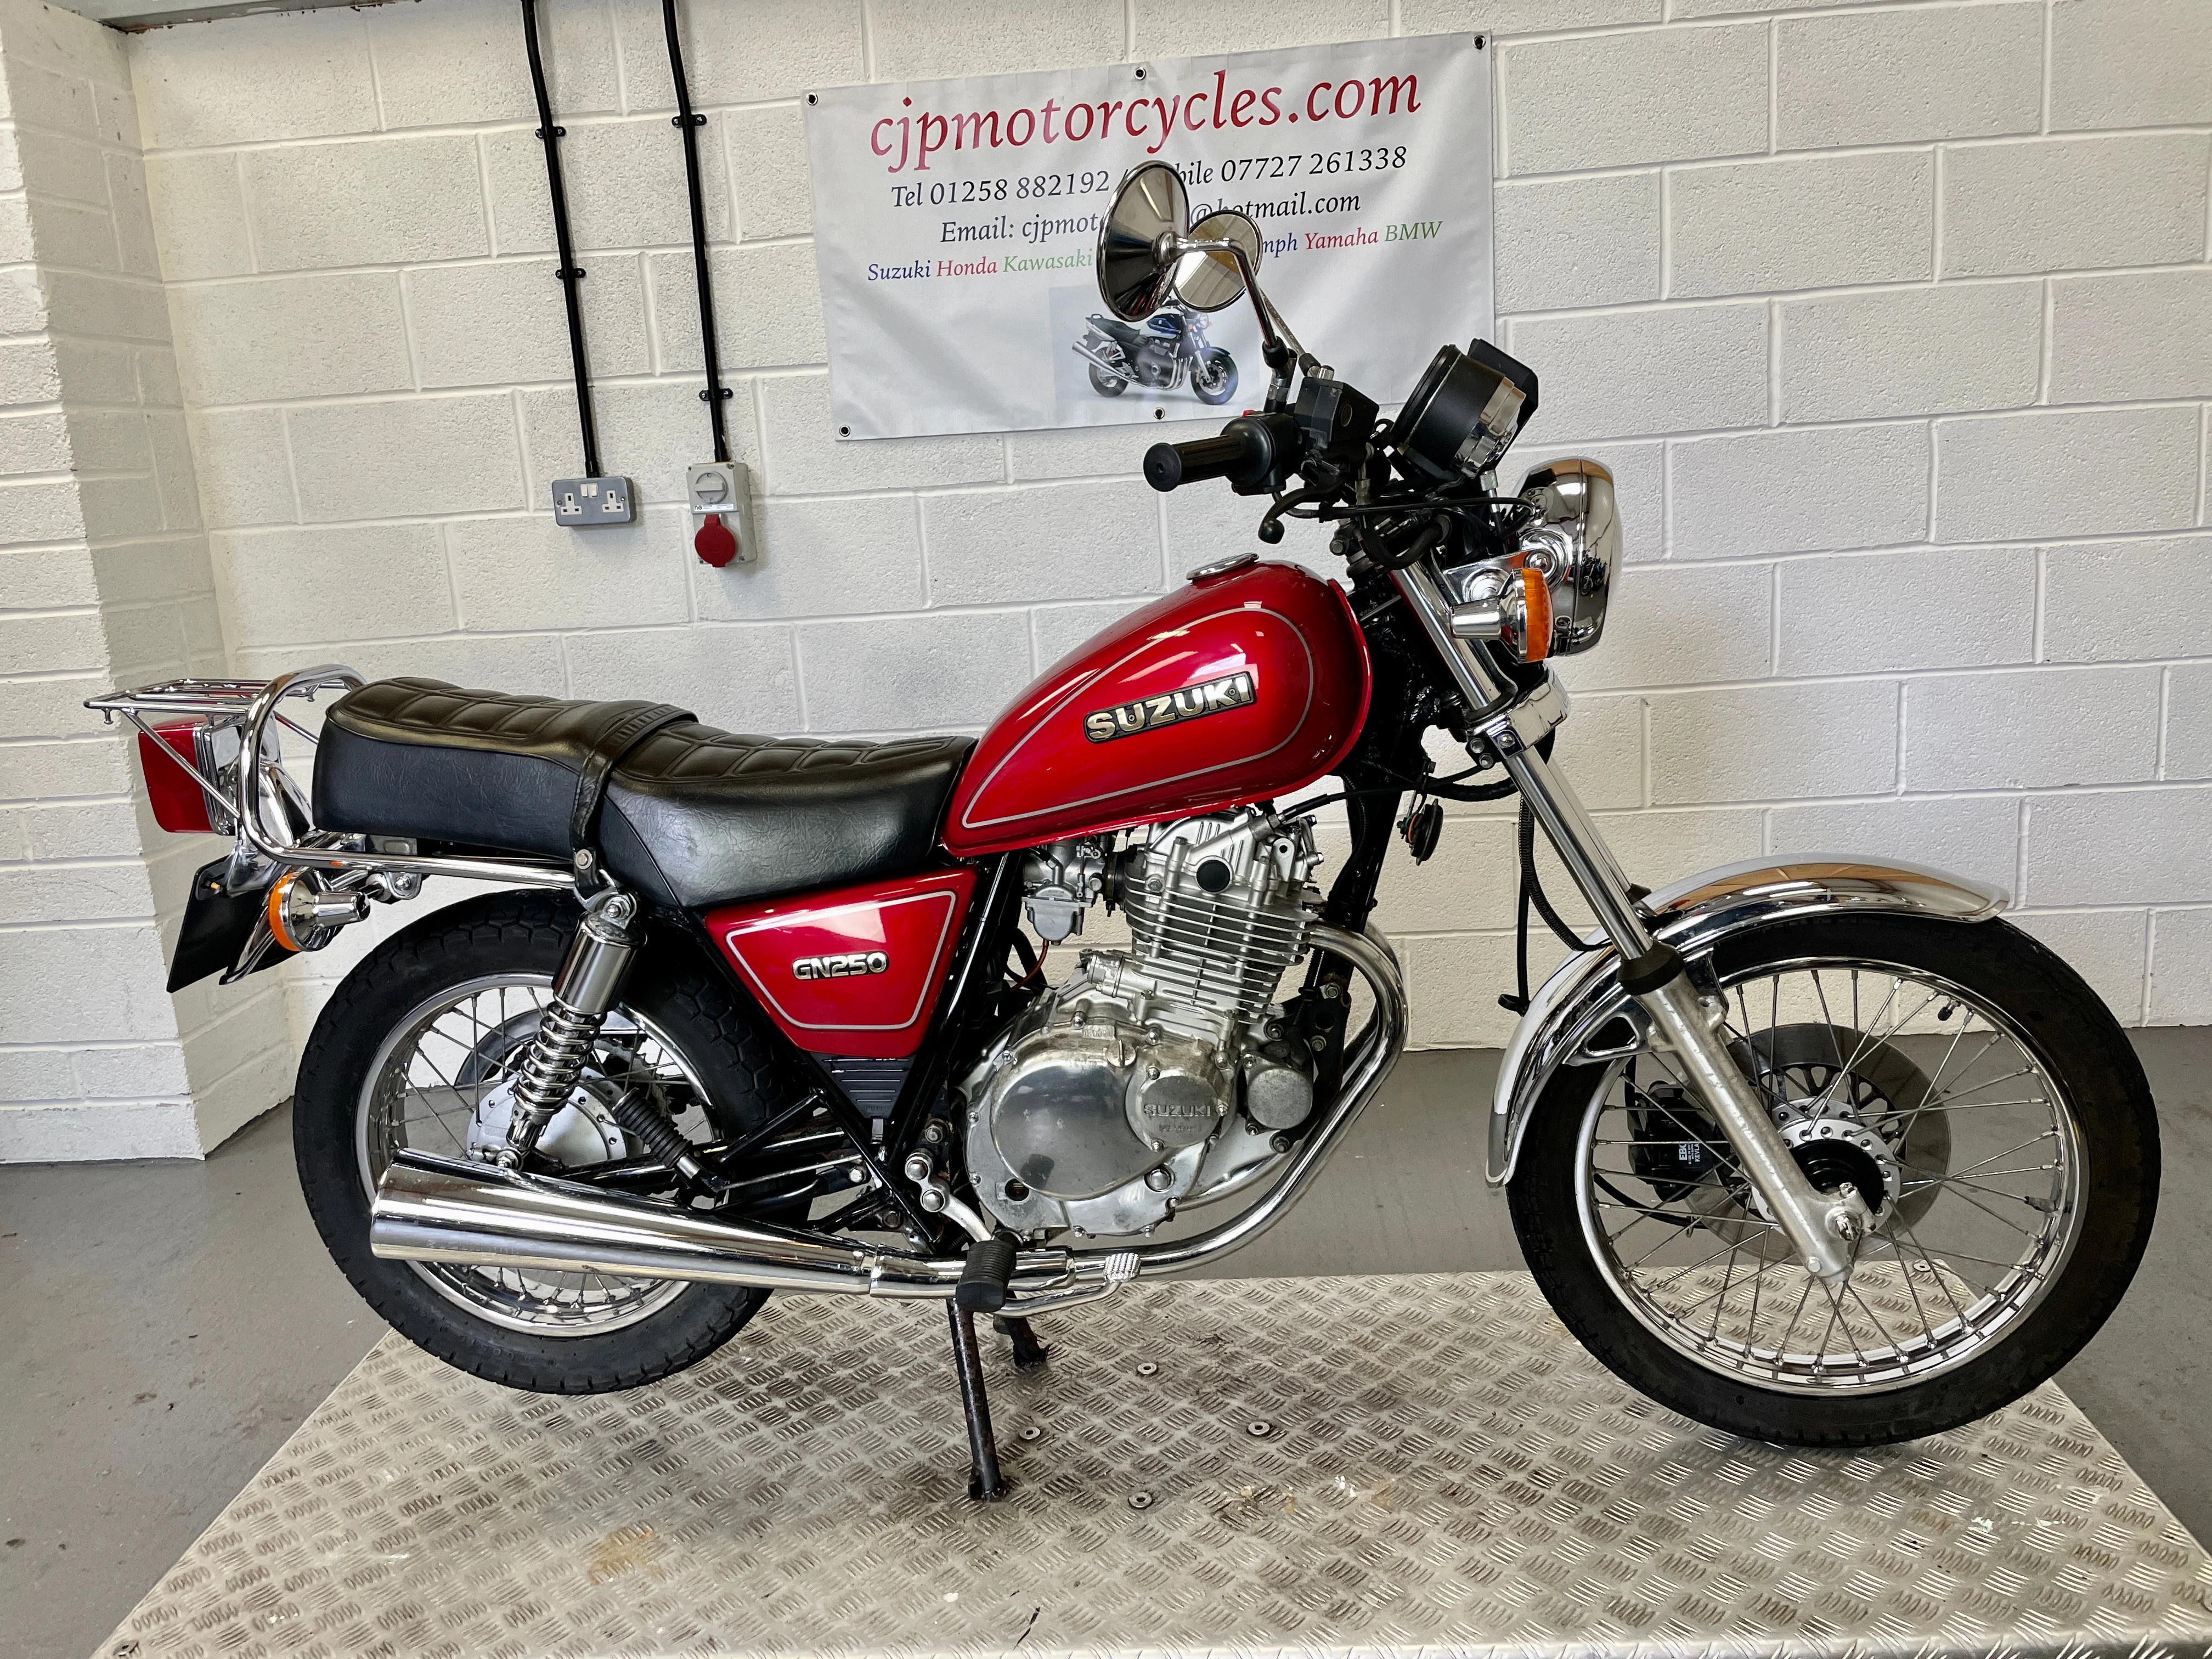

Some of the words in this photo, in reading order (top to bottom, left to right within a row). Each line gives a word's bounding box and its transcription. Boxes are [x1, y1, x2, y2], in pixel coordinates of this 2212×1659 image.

[871, 69, 1421, 173] cjpmotorcycles.com
[891, 183, 923, 208] Tel
[930, 179, 1008, 206] 01258
[1017, 170, 1109, 200] 882192
[1221, 155, 1302, 182] 07727
[1308, 145, 1407, 175] 261338
[868, 260, 931, 281] Suzuki
[936, 256, 997, 277] Honda
[1002, 249, 1093, 273] Kawasaki
[1304, 227, 1379, 251] Yamaha
[1385, 221, 1442, 242] BMW
[940, 215, 1014, 243] Email:
[1086, 675, 1252, 740] SUZUKI
[792, 952, 887, 980] GN250
[1143, 1104, 1211, 1117] SUZUKI
